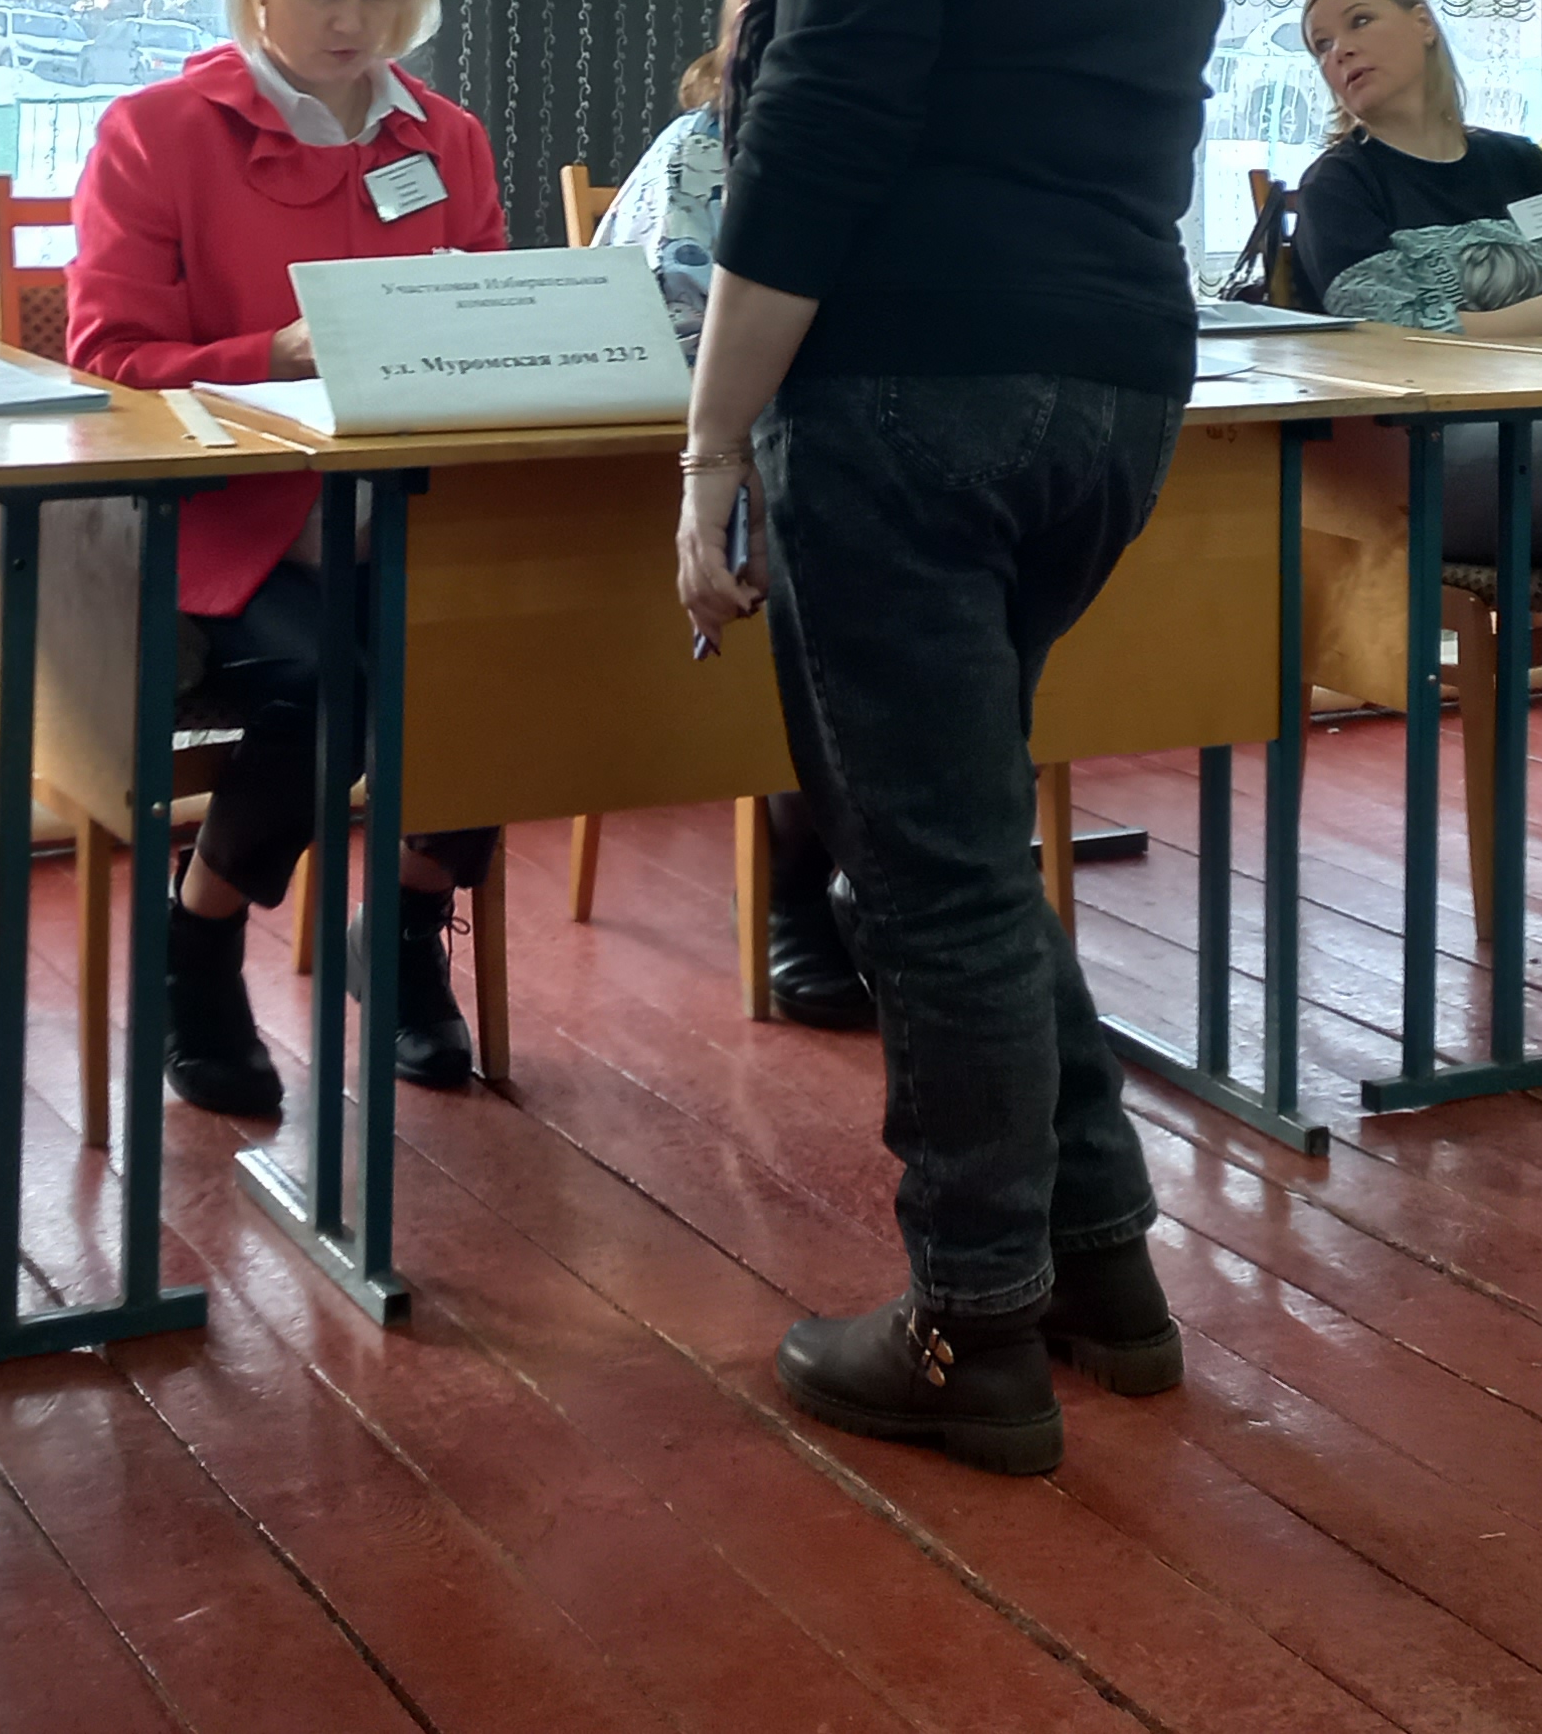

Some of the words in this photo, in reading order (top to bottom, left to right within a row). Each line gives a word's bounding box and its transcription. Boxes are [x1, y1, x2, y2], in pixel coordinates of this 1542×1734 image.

[421, 352, 552, 377] Муромская
[557, 350, 598, 367] дом
[602, 346, 650, 364] 23/2
